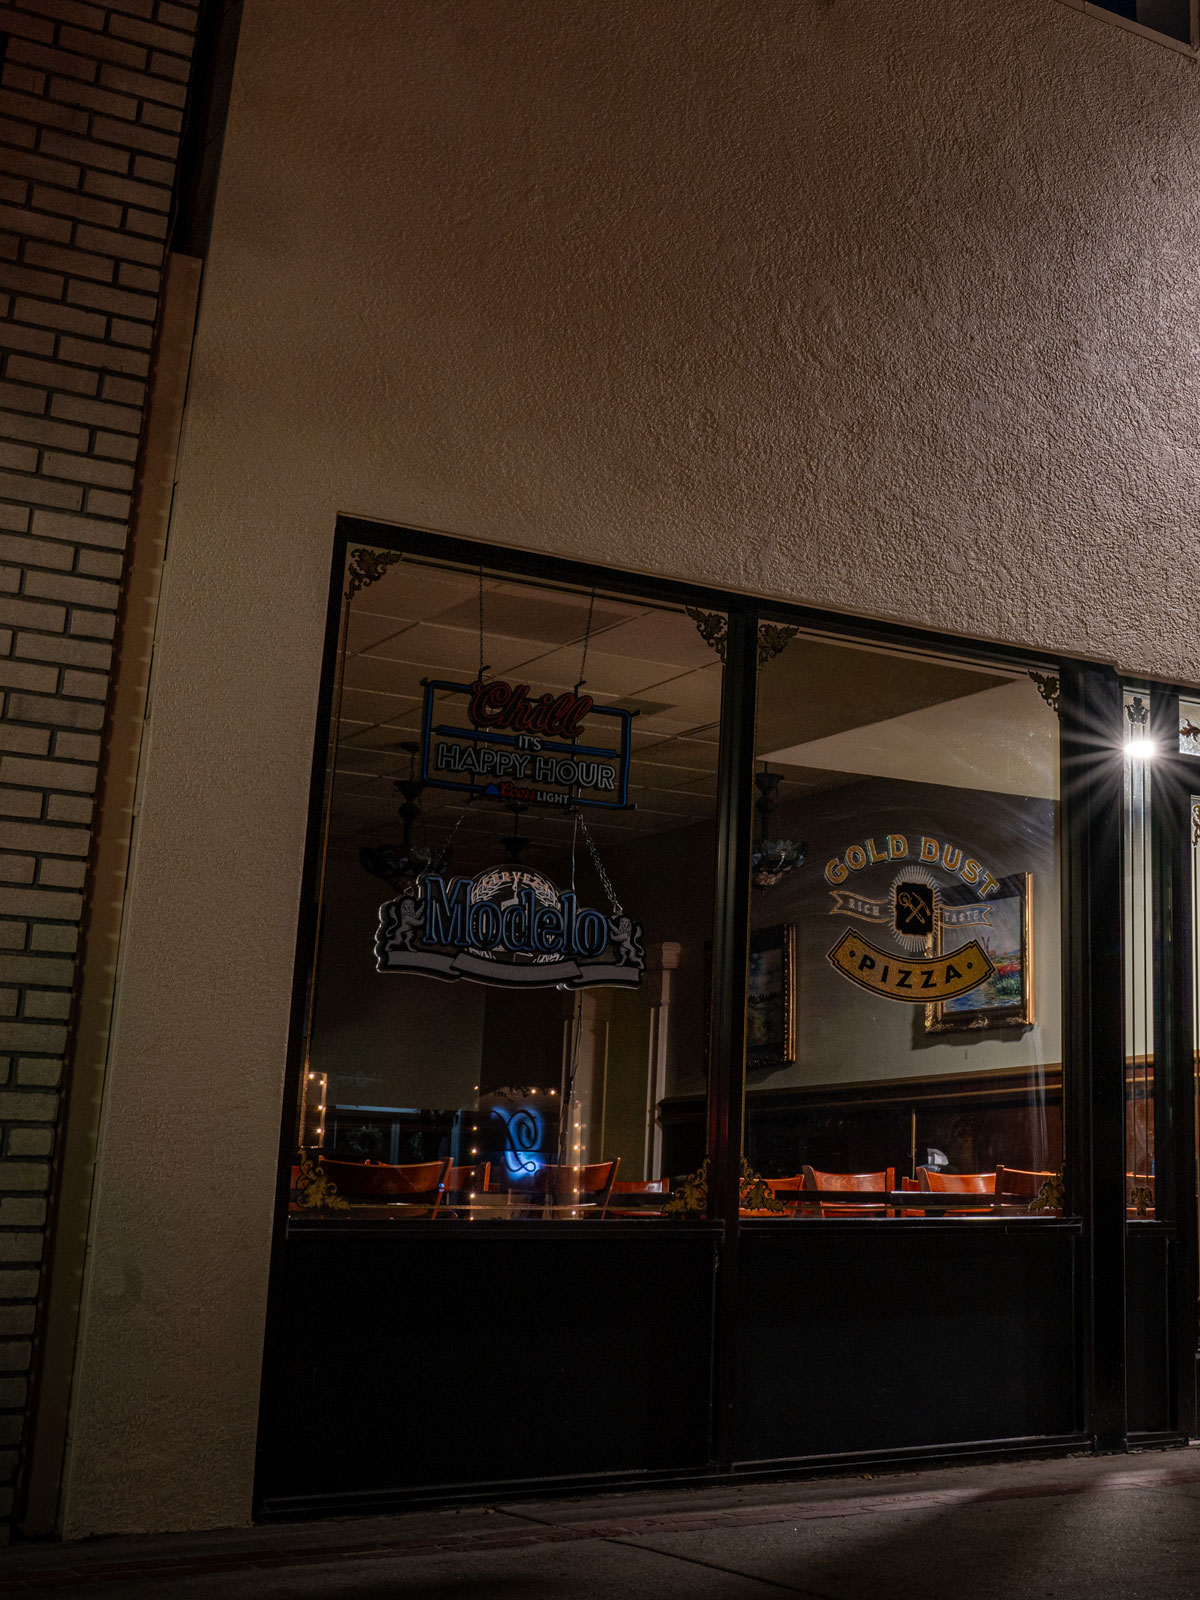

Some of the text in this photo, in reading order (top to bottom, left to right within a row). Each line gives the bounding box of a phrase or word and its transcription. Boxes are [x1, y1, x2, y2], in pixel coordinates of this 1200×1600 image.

[469, 681, 594, 738] Chill
[518, 735, 542, 751] IT'S
[436, 743, 616, 790] HAPPY HOUR
[500, 782, 570, 805] Coors LIGHT
[482, 871, 550, 894] CERVEZA
[824, 834, 1000, 899] GOLD DUST
[422, 876, 610, 957] Modelo
[849, 899, 979, 923] RICH TASTE
[857, 955, 963, 989] PIZZA
